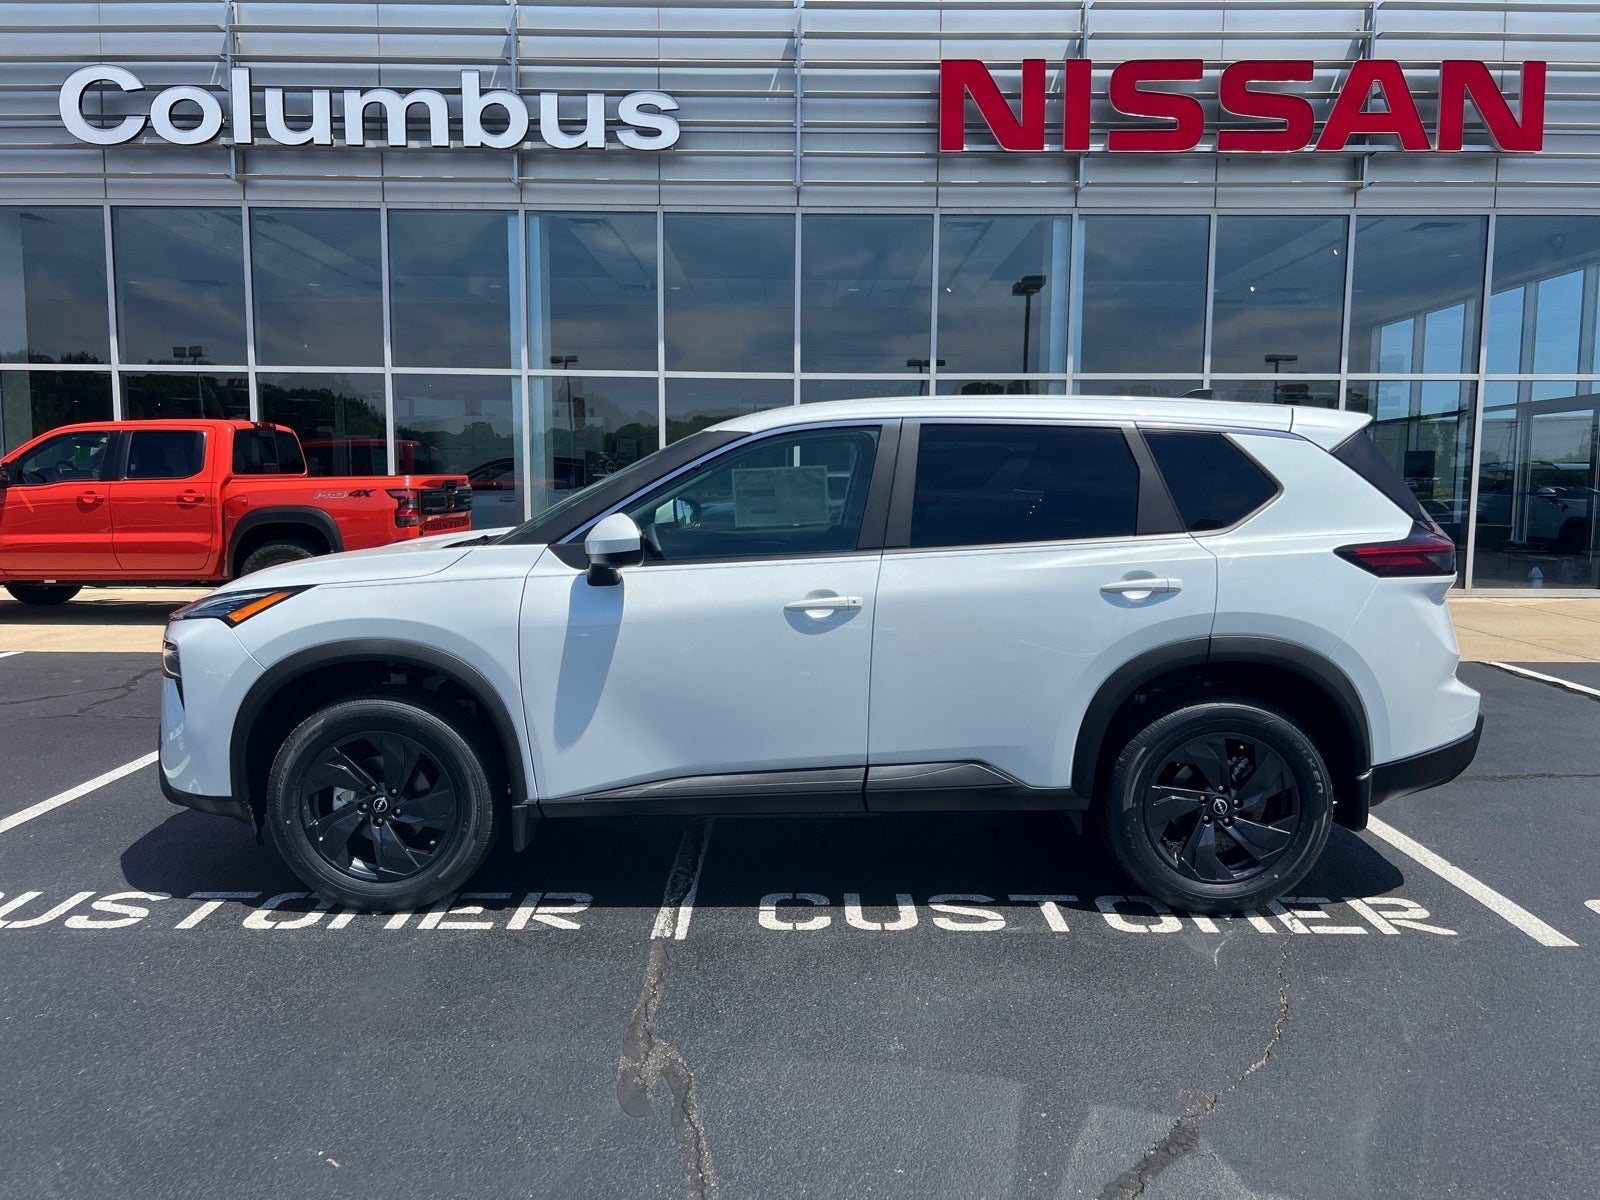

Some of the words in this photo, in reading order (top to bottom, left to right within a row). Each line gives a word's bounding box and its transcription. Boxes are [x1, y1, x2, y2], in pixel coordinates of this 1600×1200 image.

[59, 64, 681, 150] Columbus
[938, 58, 1547, 154] NISSAN
[0, 891, 594, 930] USTOER
